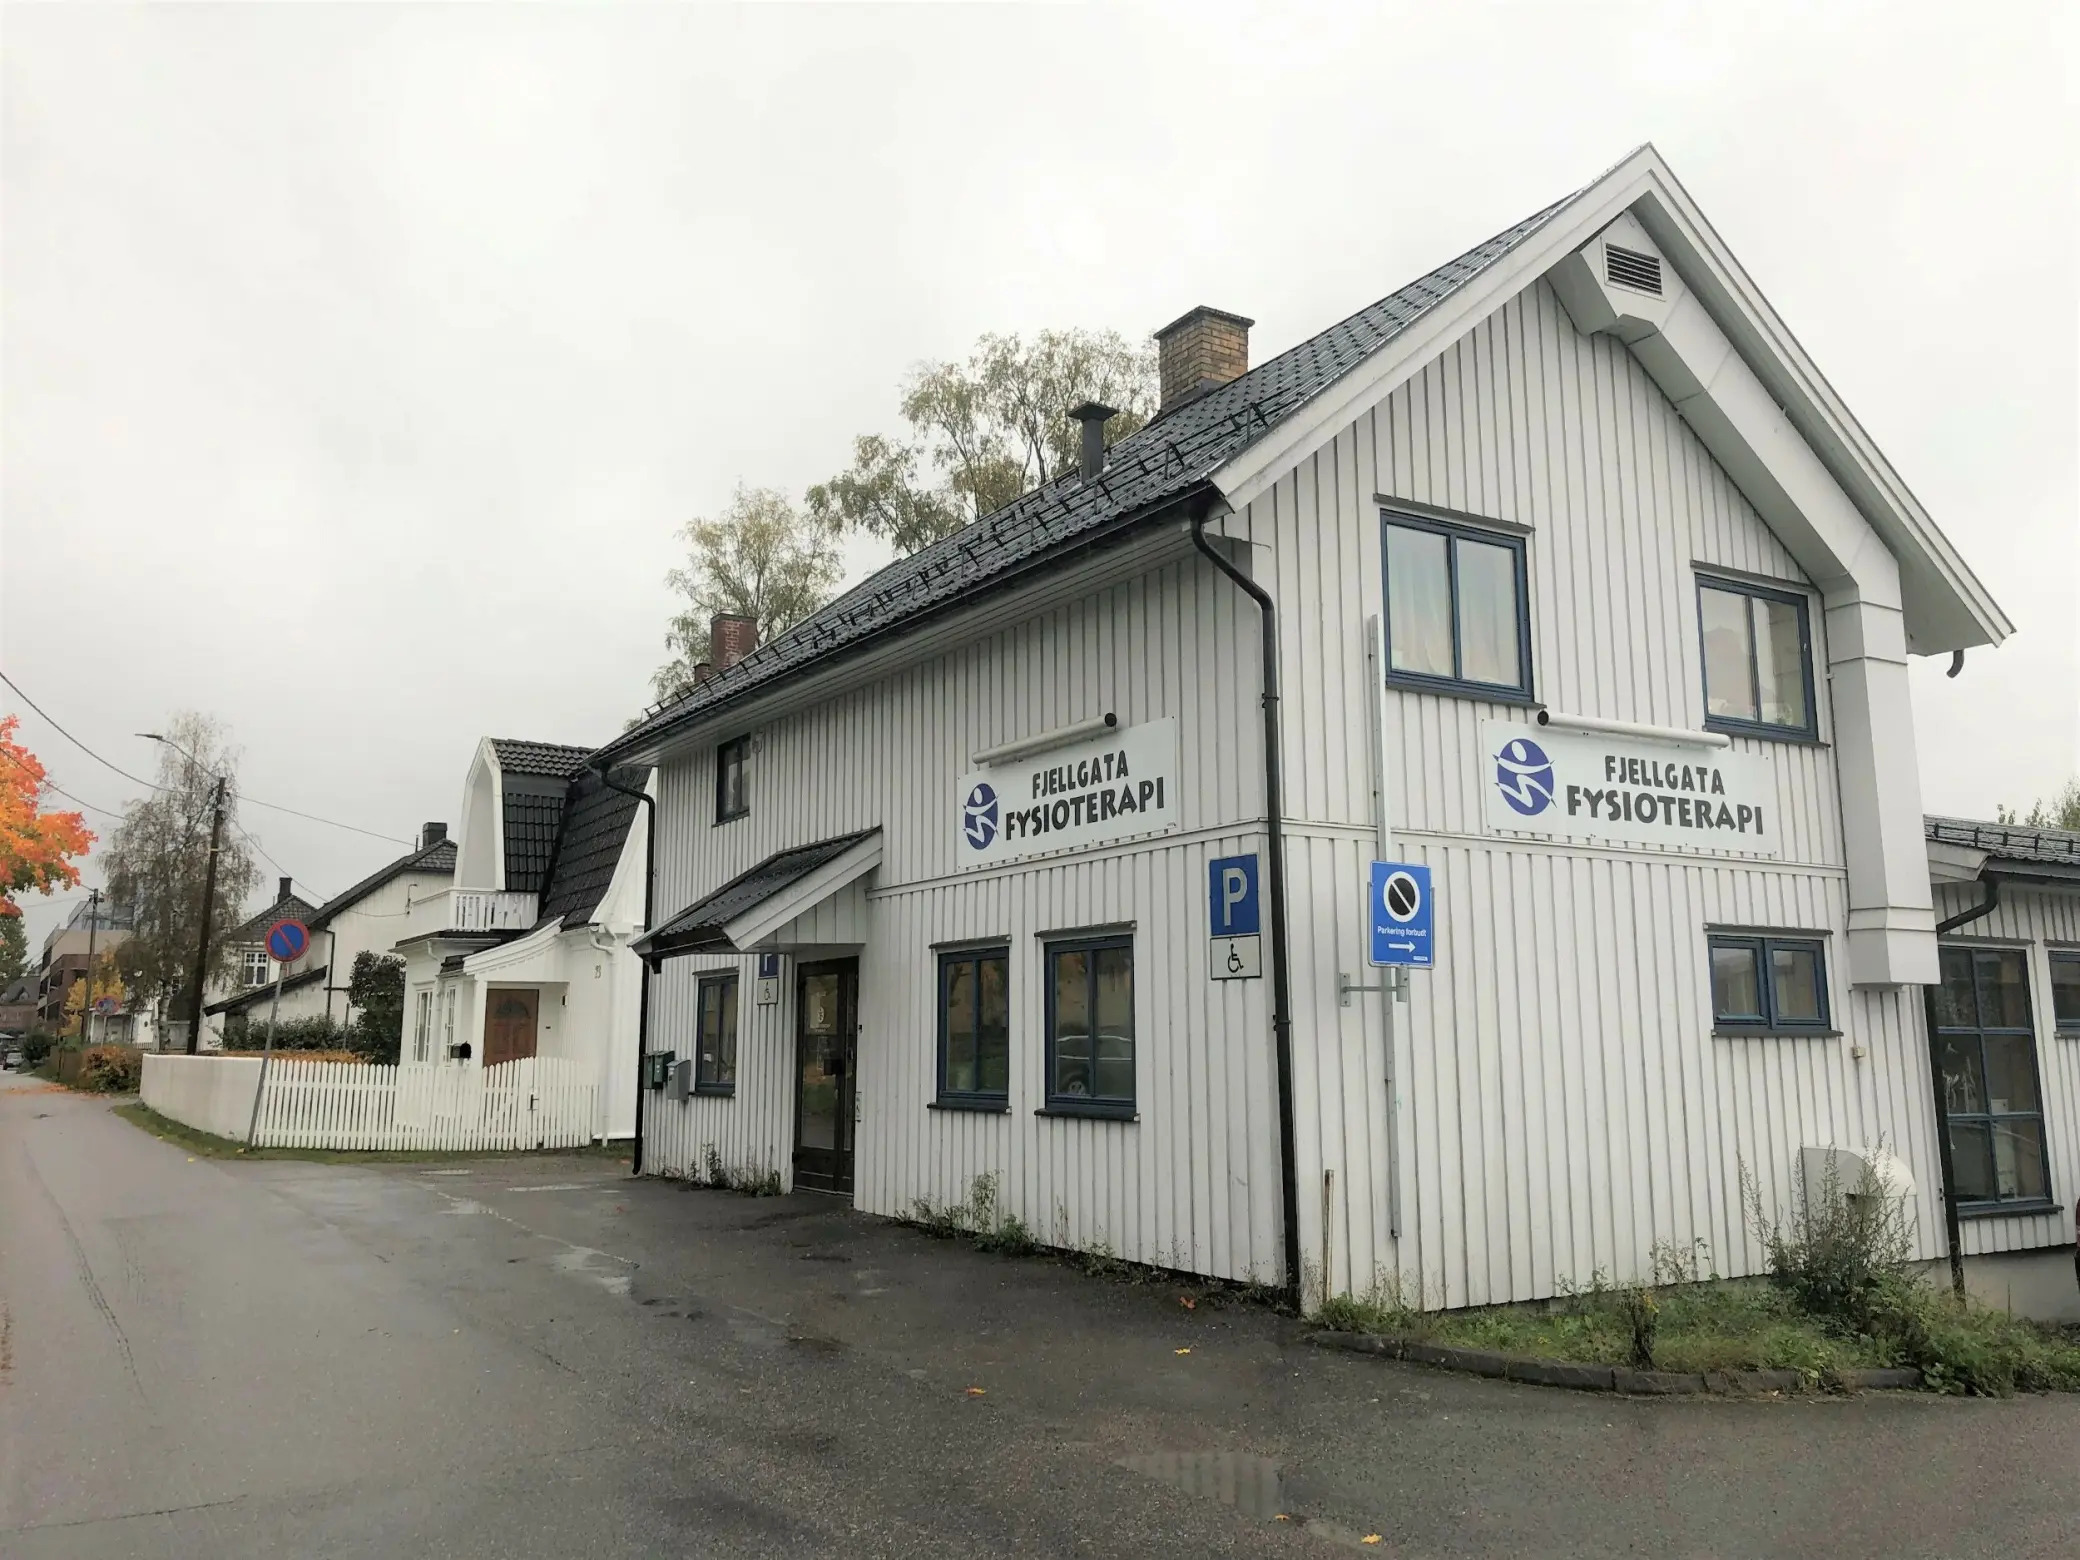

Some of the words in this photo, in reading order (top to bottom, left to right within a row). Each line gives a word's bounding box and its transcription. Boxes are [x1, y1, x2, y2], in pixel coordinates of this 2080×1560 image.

[1032, 750, 1129, 799] FJELLGATA
[1605, 755, 1726, 795] FJELLGATA
[1005, 776, 1165, 841] FYSIOTERAPI
[1566, 784, 1764, 835] FYSIOTERAPI
[1222, 867, 1248, 927] P
[1377, 925, 1405, 937] Parkering
[1405, 928, 1427, 937] forbudt
